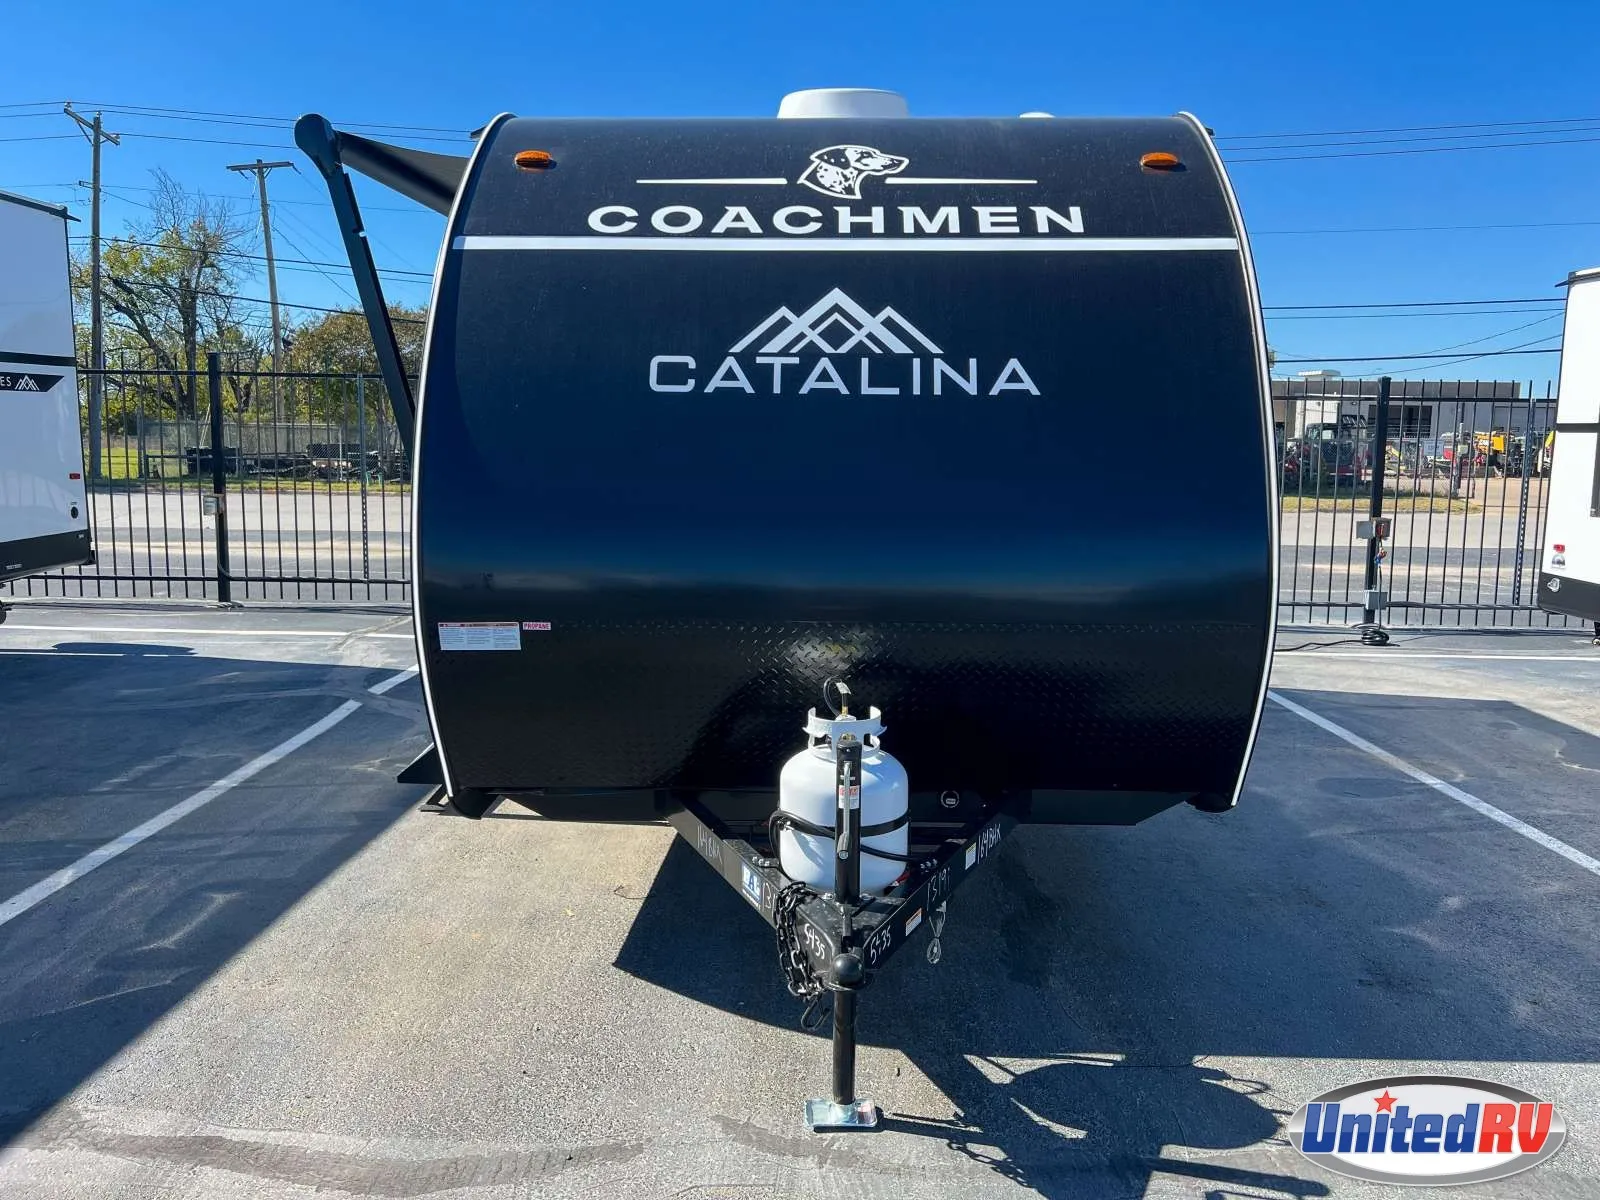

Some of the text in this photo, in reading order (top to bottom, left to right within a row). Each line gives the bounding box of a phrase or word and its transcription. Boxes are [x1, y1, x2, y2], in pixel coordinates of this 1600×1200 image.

[587, 205, 1084, 234] COACHMEN
[648, 355, 1041, 395] CATALINA
[523, 622, 550, 630] PROPANE
